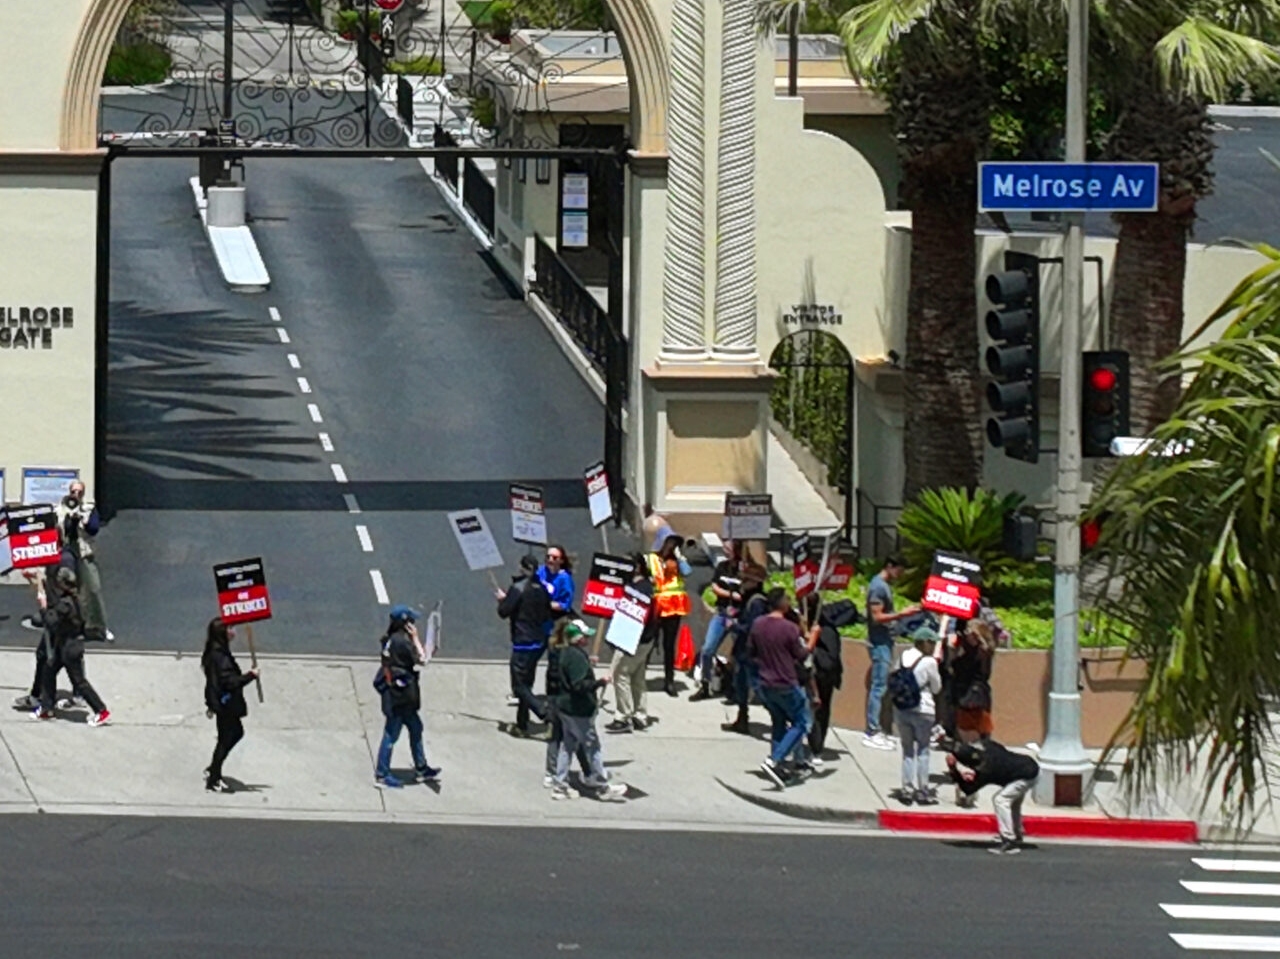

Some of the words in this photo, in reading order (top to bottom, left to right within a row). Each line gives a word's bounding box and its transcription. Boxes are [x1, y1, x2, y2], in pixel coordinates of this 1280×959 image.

[993, 173, 1102, 198] Melrose
[1111, 173, 1145, 198] Av
[783, 314, 843, 326] ENTRANCE
